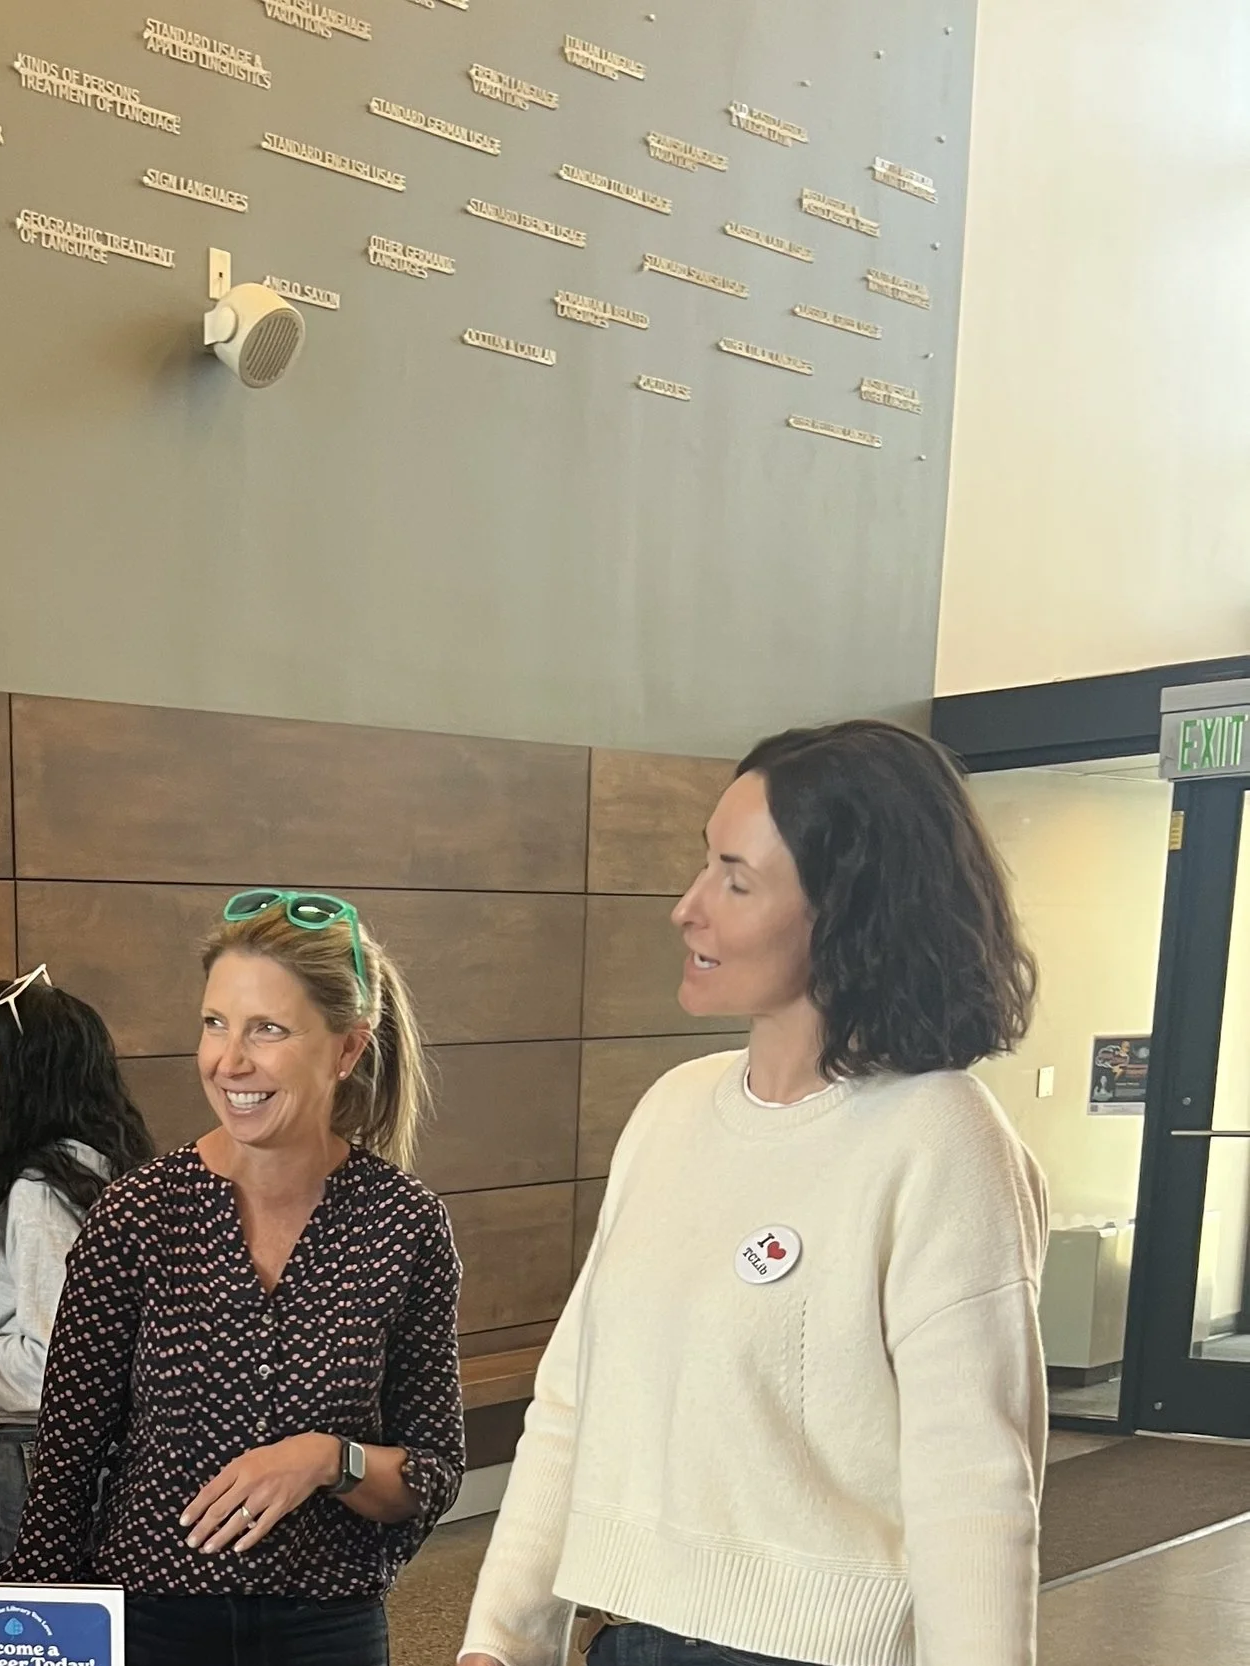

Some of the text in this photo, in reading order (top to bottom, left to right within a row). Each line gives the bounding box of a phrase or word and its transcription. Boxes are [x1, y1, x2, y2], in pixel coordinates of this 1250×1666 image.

[264, 4, 332, 38] VARIATIONS
[146, 18, 210, 51] STANDARD
[213, 40, 253, 64] USAGE
[18, 53, 141, 104] KINDS OF PERSONS
[147, 37, 271, 90] APPLIED LINGUISTICS
[20, 74, 180, 135] TREATMENT OF LANGUAGE
[372, 97, 426, 129] STANDARD
[264, 132, 406, 190] STANDARD ENGLISH USAGE
[147, 169, 248, 210] SIGN LANGUAGES
[470, 198, 518, 226] STANDARD
[20, 209, 175, 265] GEOGRAPHIC TREATMENT
[20, 229, 108, 264] OF LANGUAGE
[371, 235, 403, 257] OTHER
[264, 275, 340, 309] ANGLO SAXON
[1178, 714, 1248, 771] EXIT
[757, 1233, 775, 1248] I
[6, 1605, 31, 1615] Library
[47, 1646, 59, 1656] a
